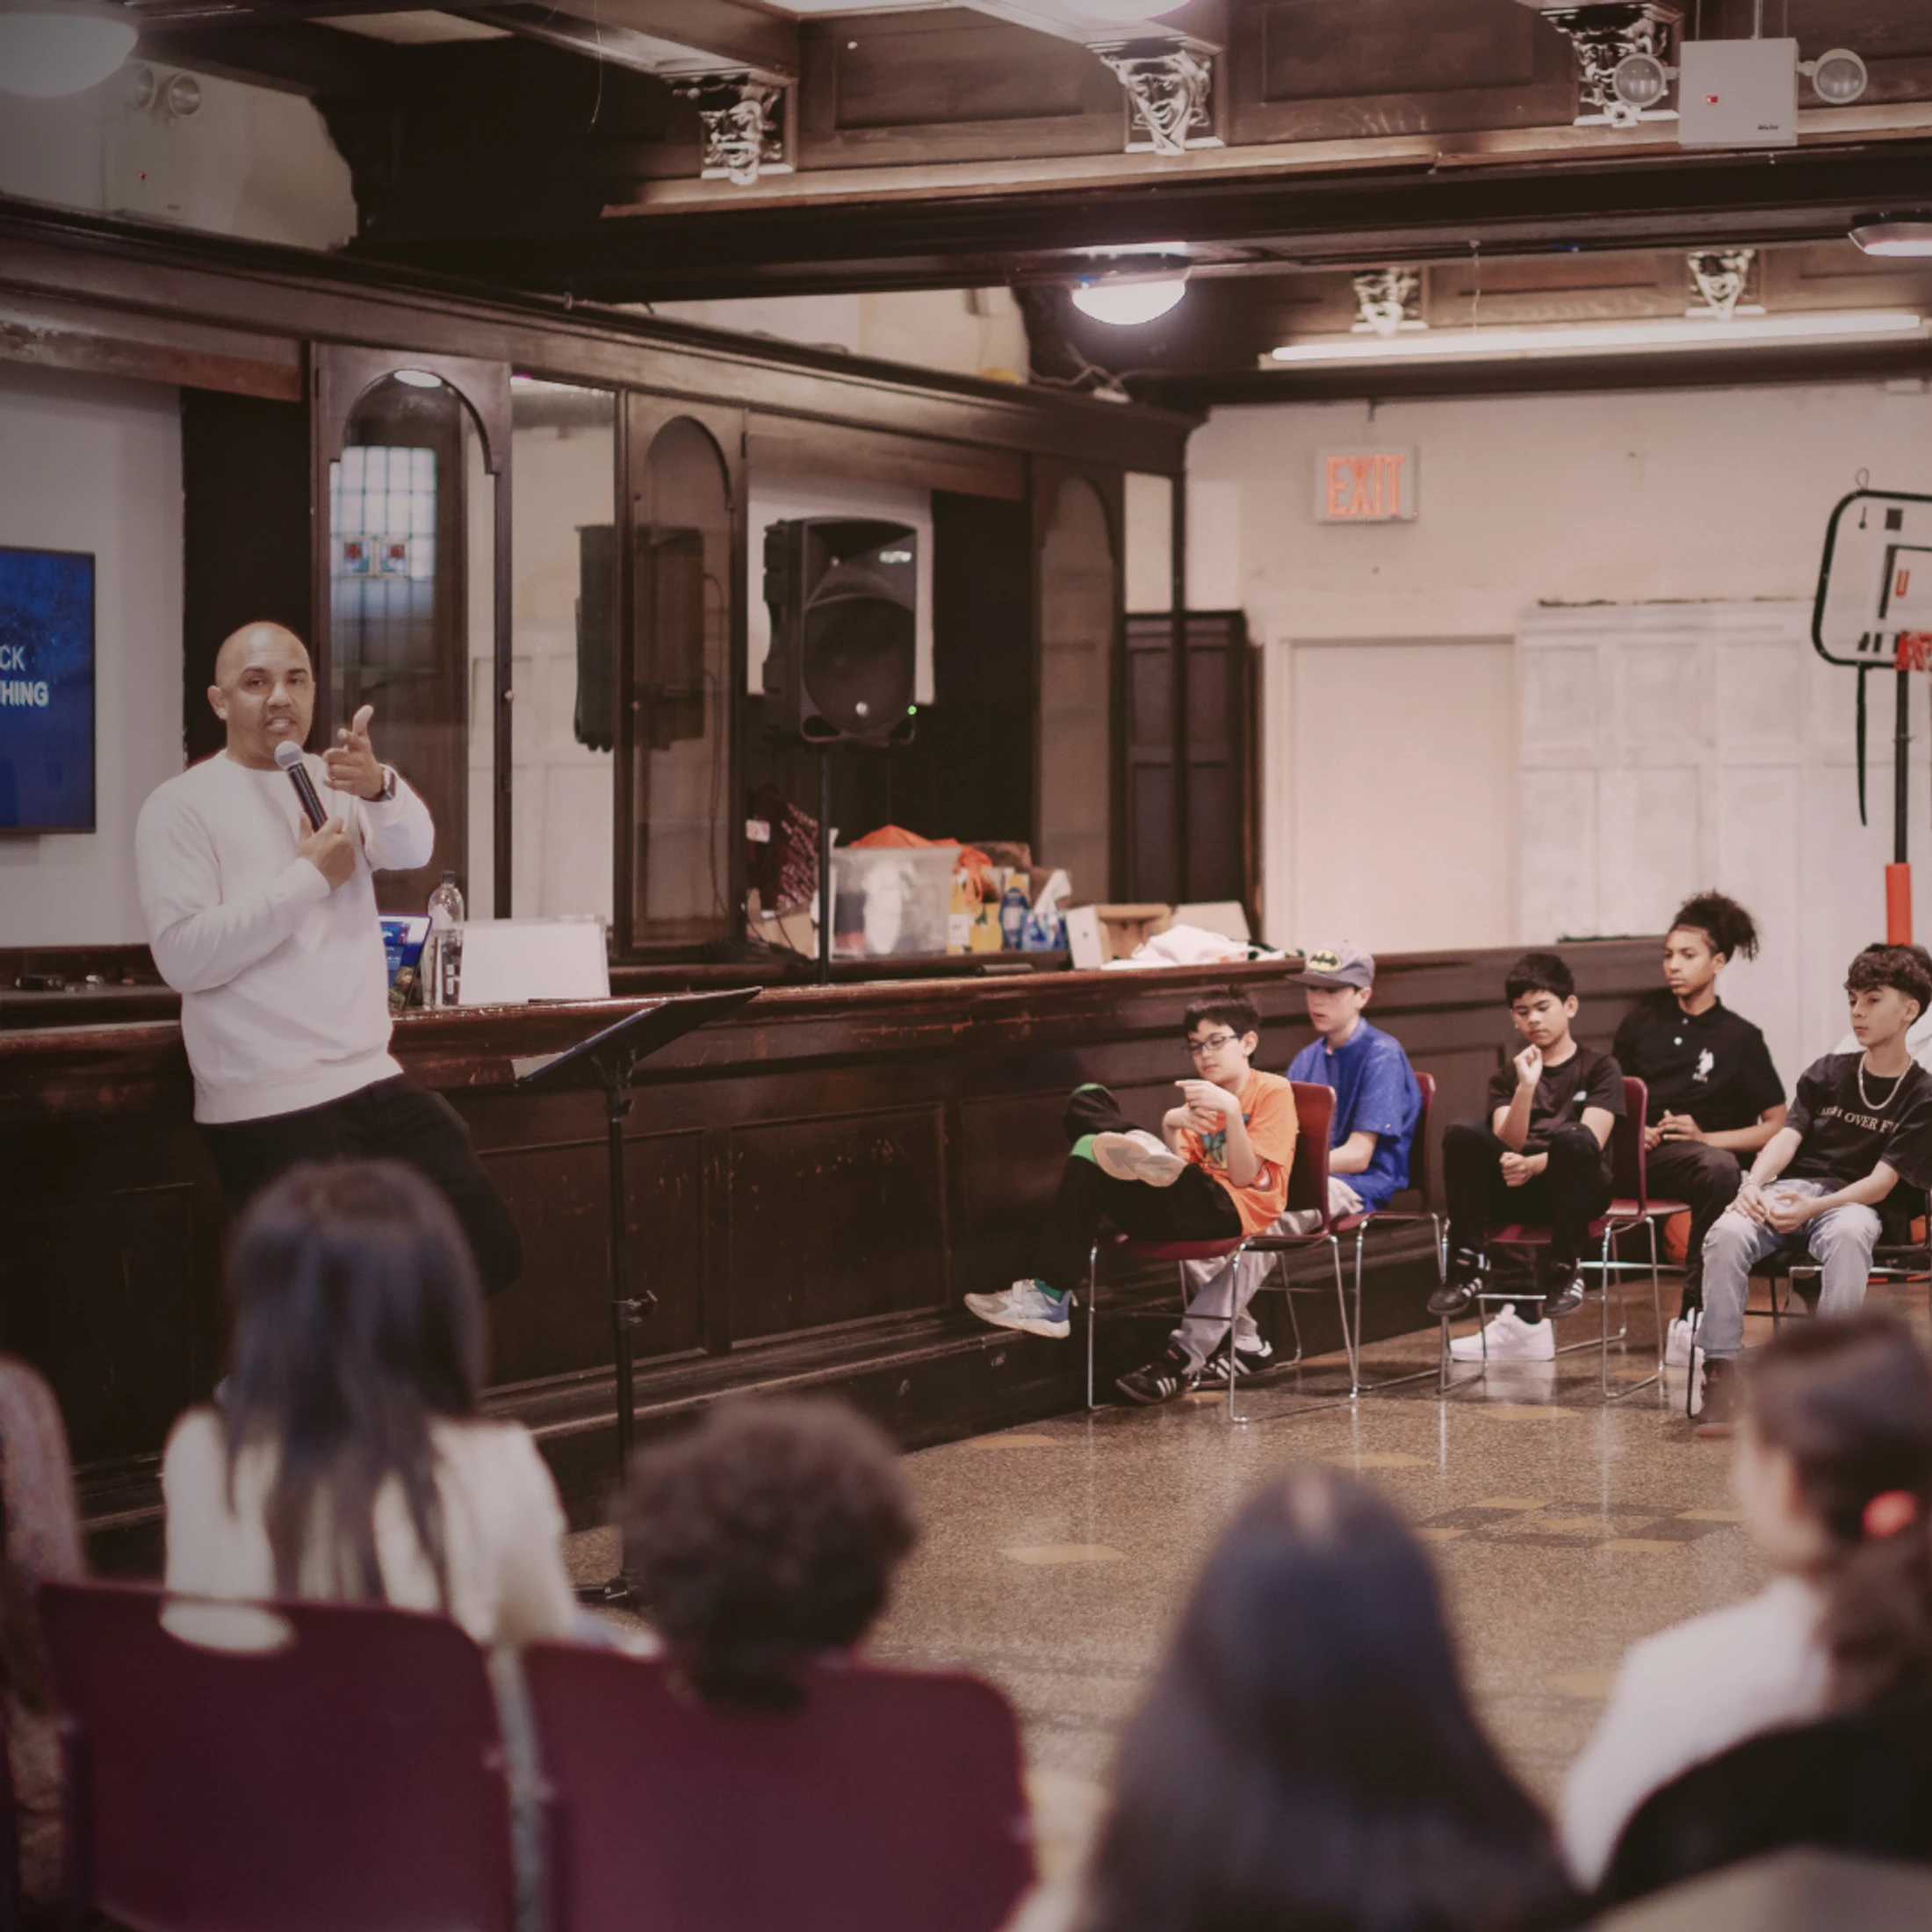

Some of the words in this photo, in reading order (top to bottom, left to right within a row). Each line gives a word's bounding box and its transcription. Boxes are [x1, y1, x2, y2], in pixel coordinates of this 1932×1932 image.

[1325, 454, 1405, 516] EXIT
[0, 680, 49, 708] HING
[1844, 1112, 1878, 1130] OVER
